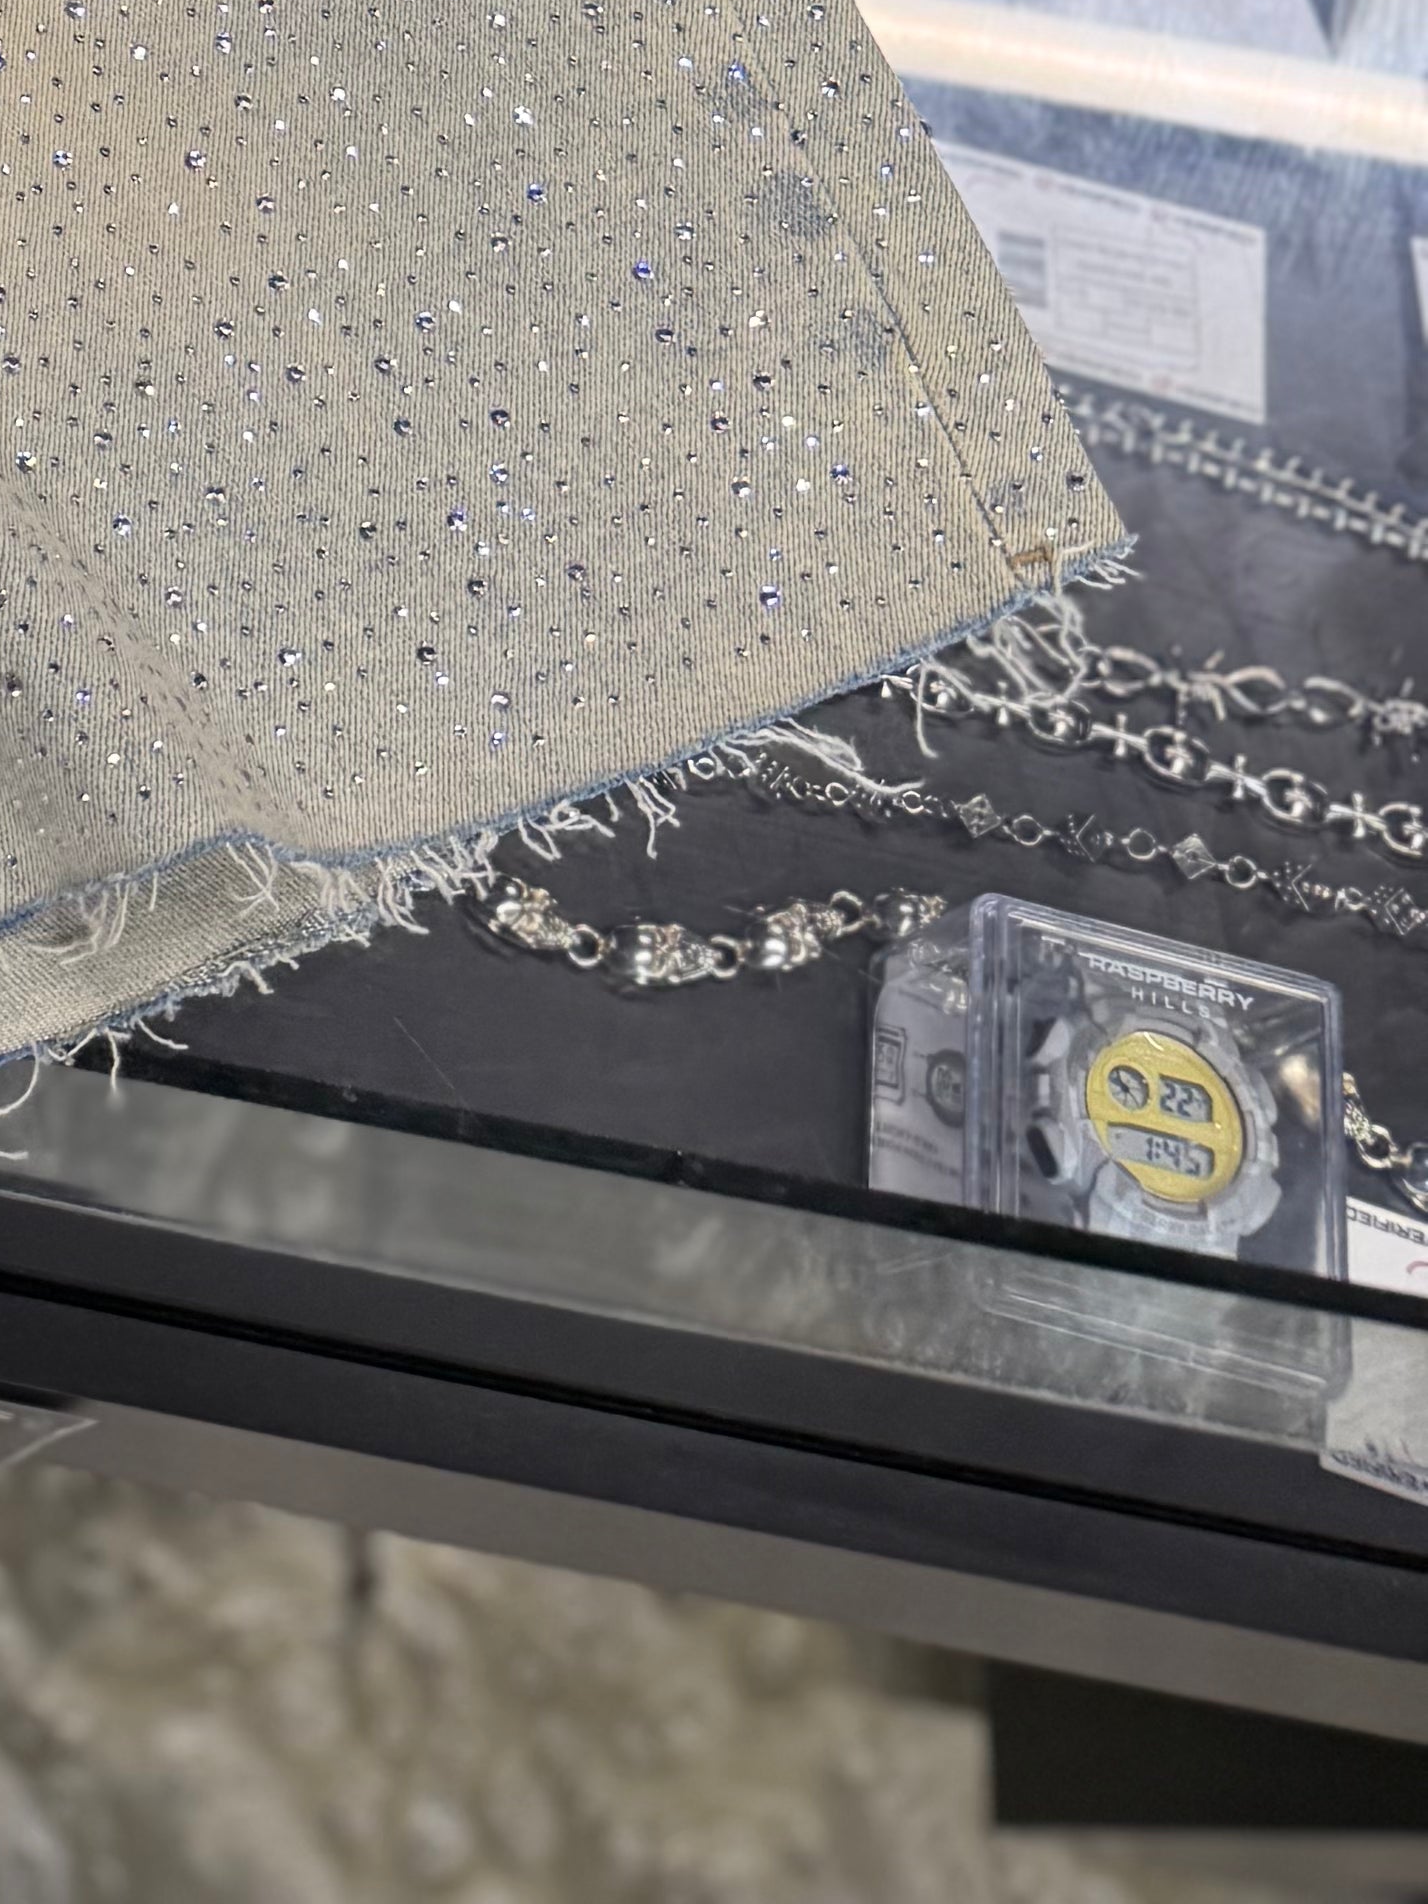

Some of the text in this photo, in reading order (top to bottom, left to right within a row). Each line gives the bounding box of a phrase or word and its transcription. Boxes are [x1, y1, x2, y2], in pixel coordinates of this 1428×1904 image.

[1088, 954, 1254, 1012] RASPBERRY
[1131, 986, 1210, 1020] HILLS
[1346, 1204, 1428, 1246] ERIFIED
